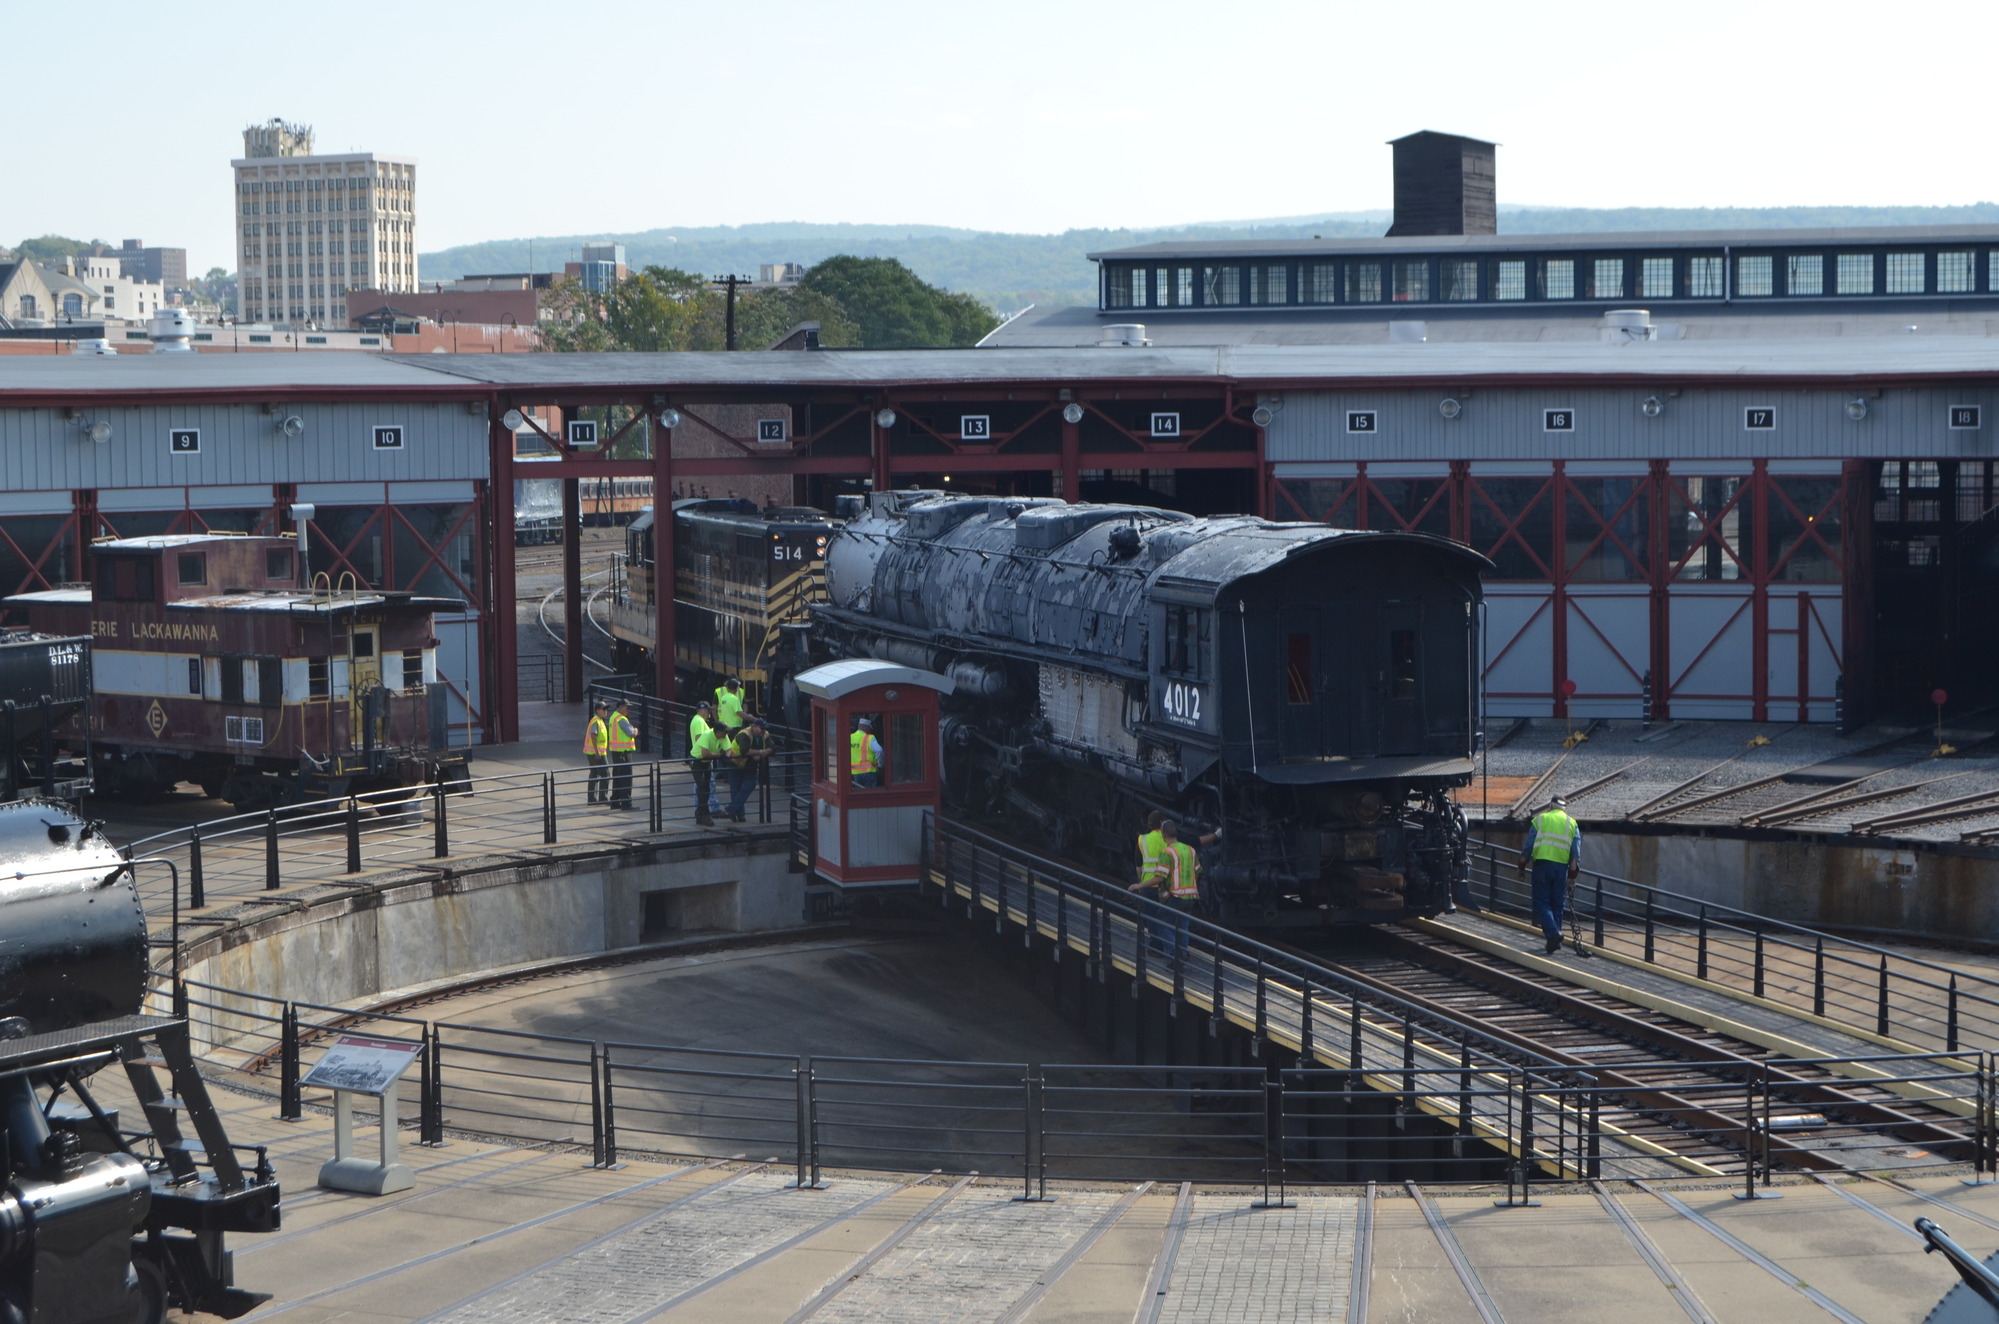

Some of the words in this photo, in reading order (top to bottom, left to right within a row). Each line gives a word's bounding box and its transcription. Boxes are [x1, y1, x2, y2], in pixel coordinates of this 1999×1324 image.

[1159, 418, 1172, 430] 14
[1355, 416, 1368, 428] 15
[1553, 414, 1565, 427] 16
[1754, 412, 1765, 425] 17
[1958, 411, 1971, 424] 18
[576, 426, 590, 439] 11
[765, 425, 779, 437] 12
[969, 421, 983, 433] 13
[181, 435, 189, 448] 9
[382, 431, 395, 444] 10
[774, 546, 802, 560] 514
[91, 621, 118, 637] ERIE
[132, 622, 219, 641] LACKAWANNA
[51, 653, 79, 665] 81178
[1164, 682, 1200, 720] 4012
